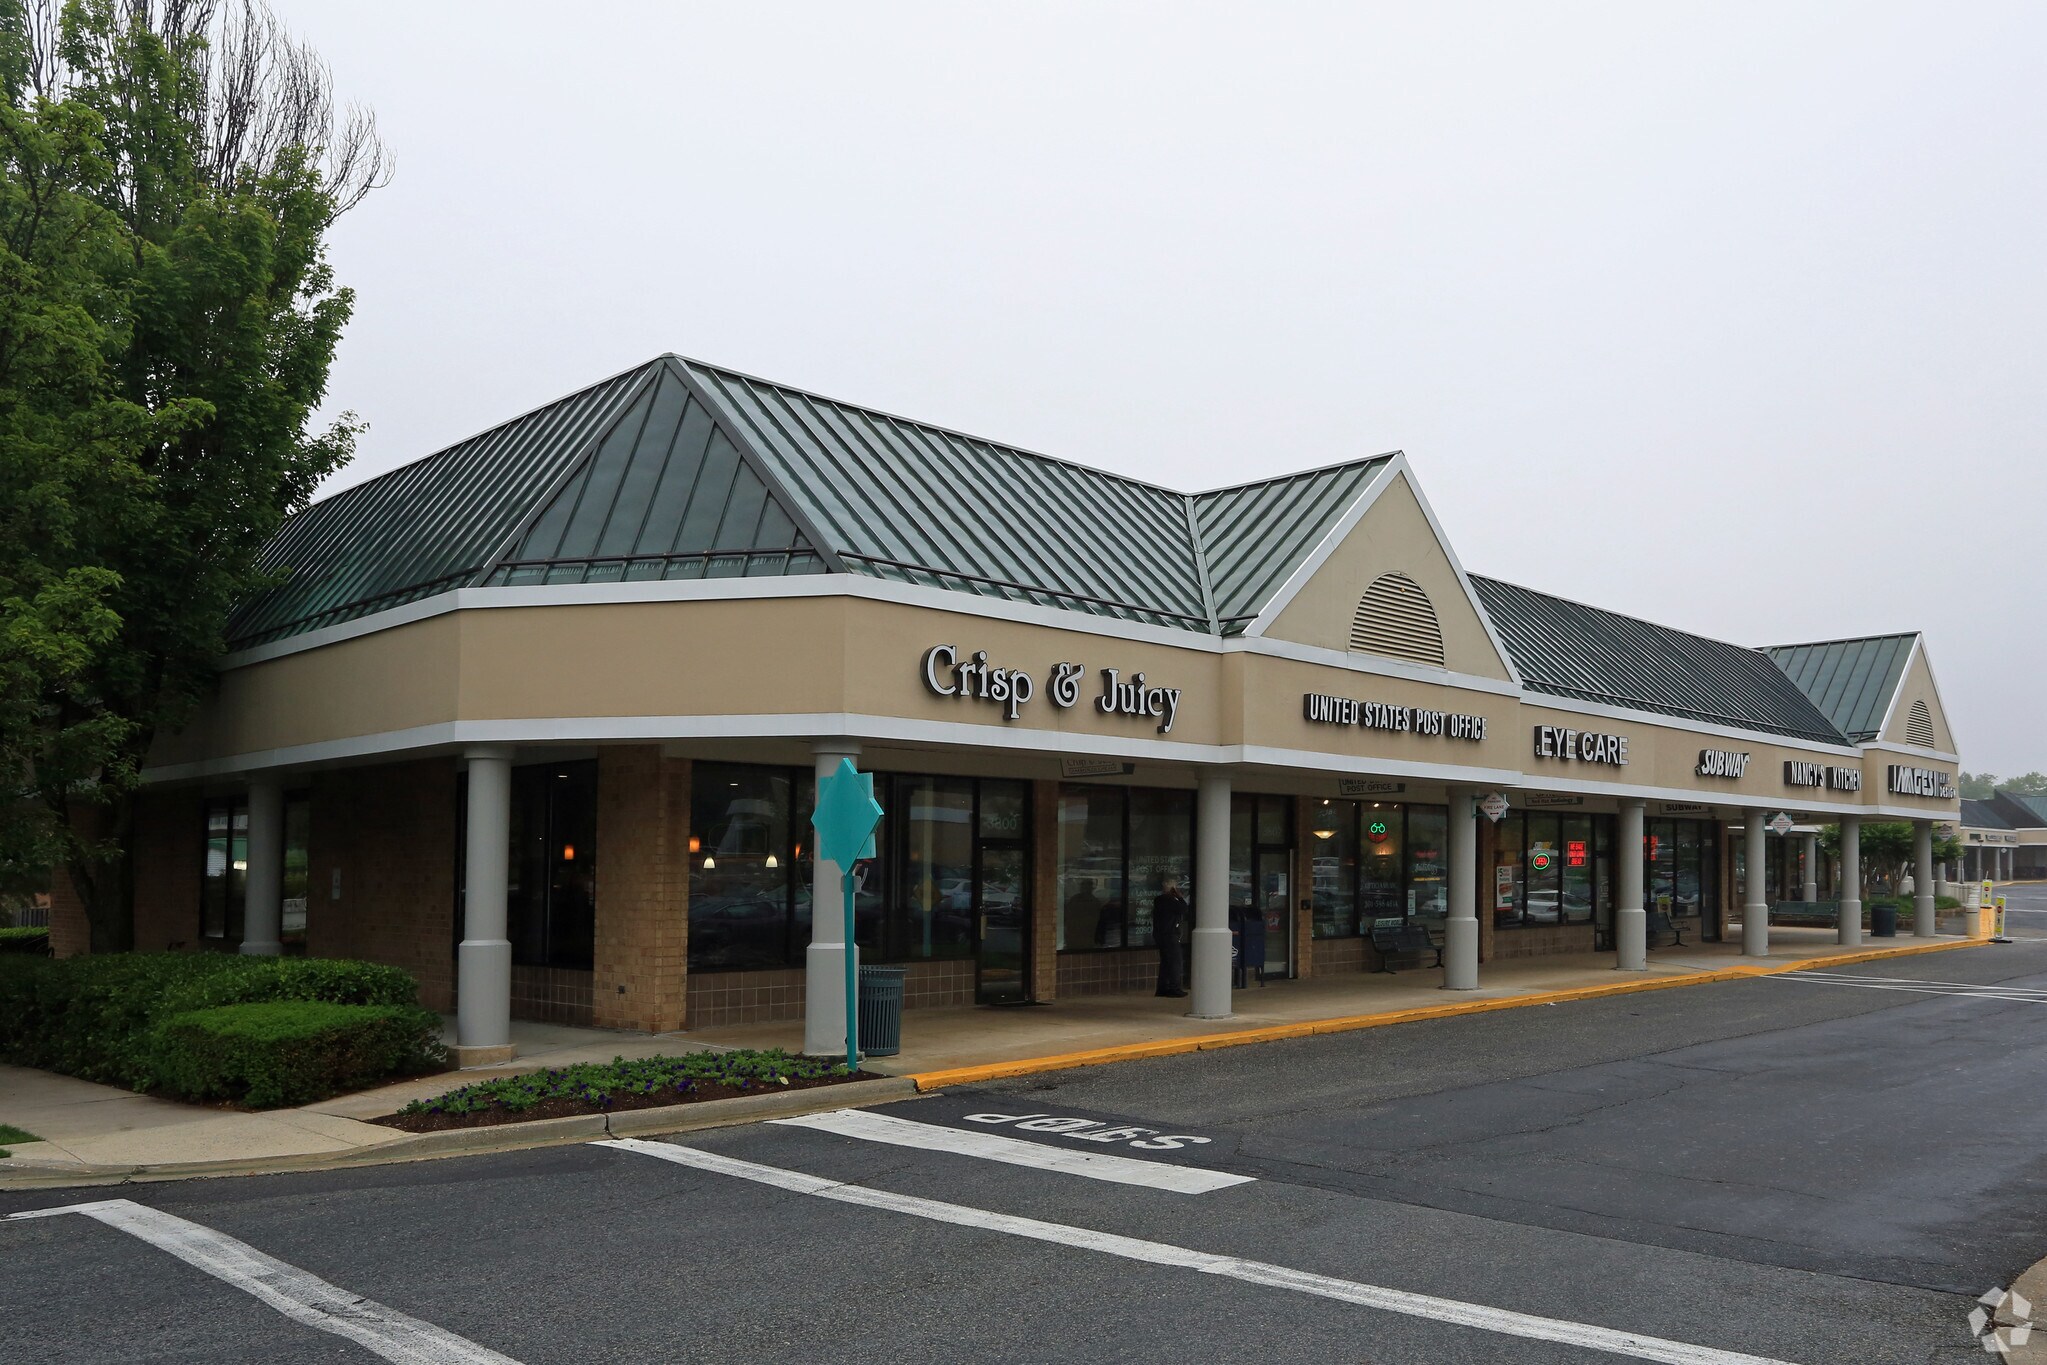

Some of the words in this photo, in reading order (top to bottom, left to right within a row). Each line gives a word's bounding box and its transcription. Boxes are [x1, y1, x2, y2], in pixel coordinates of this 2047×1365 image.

[920, 644, 1033, 720] Crisp
[1047, 661, 1084, 708] &
[1094, 668, 1181, 733] Juicy
[1305, 694, 1359, 725] UNITED
[1362, 701, 1410, 731] STATES
[1414, 708, 1445, 736] POST
[1448, 713, 1487, 741] OFFICE
[1537, 725, 1577, 759] EYE
[1579, 731, 1629, 765] CARE
[1698, 749, 1750, 778] SUBWAY
[1788, 761, 1825, 787] NANCY'S
[1830, 766, 1862, 792] KITCHEN
[1346, 784, 1365, 792] POST
[1367, 783, 1392, 791] OFFICE
[1890, 765, 1934, 796] IMAGES
